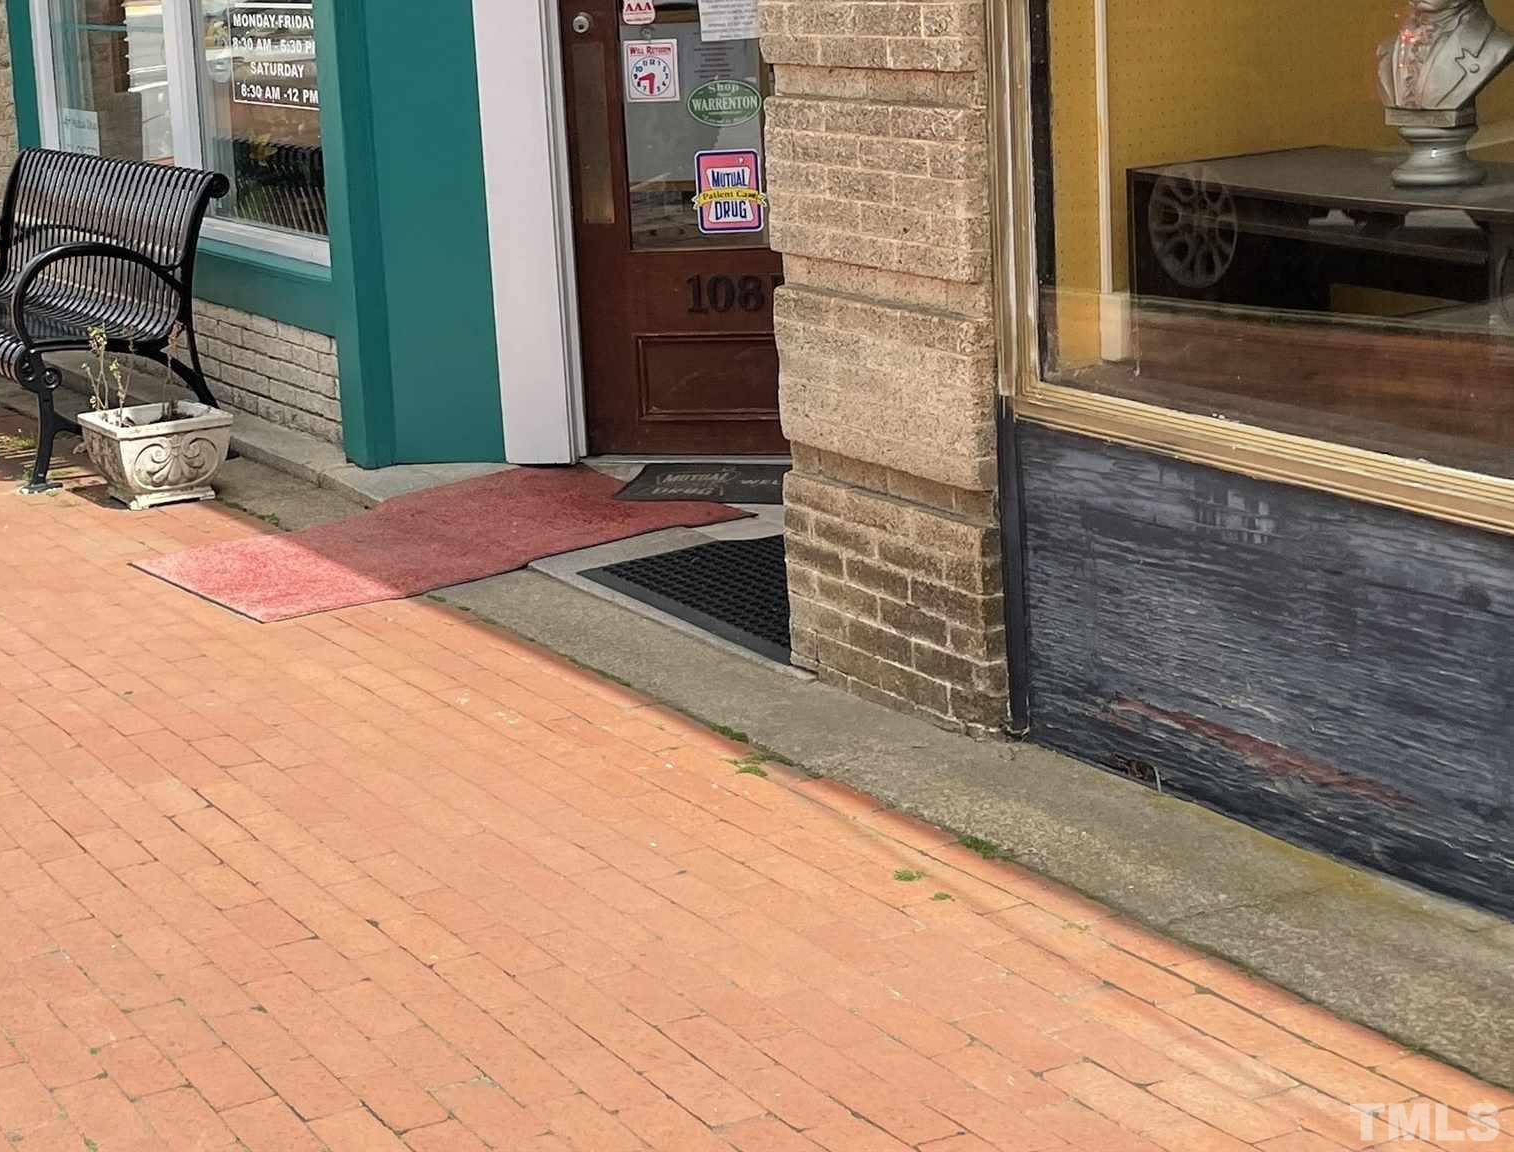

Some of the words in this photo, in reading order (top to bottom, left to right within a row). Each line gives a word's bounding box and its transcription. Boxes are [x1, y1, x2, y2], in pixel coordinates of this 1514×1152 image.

[625, 2, 652, 12] AAA
[233, 14, 315, 31] MONDAY-FRIDAY
[232, 36, 254, 52] 8:30
[257, 38, 272, 54] AM
[250, 61, 305, 79] SATURDAY
[265, 85, 280, 100] AM
[303, 89, 319, 105] PM
[692, 96, 757, 111] WARRENTON
[711, 168, 748, 188] MUTUAL
[702, 190, 734, 201] Patient
[715, 200, 747, 220] DRUG
[686, 272, 766, 315] 108
